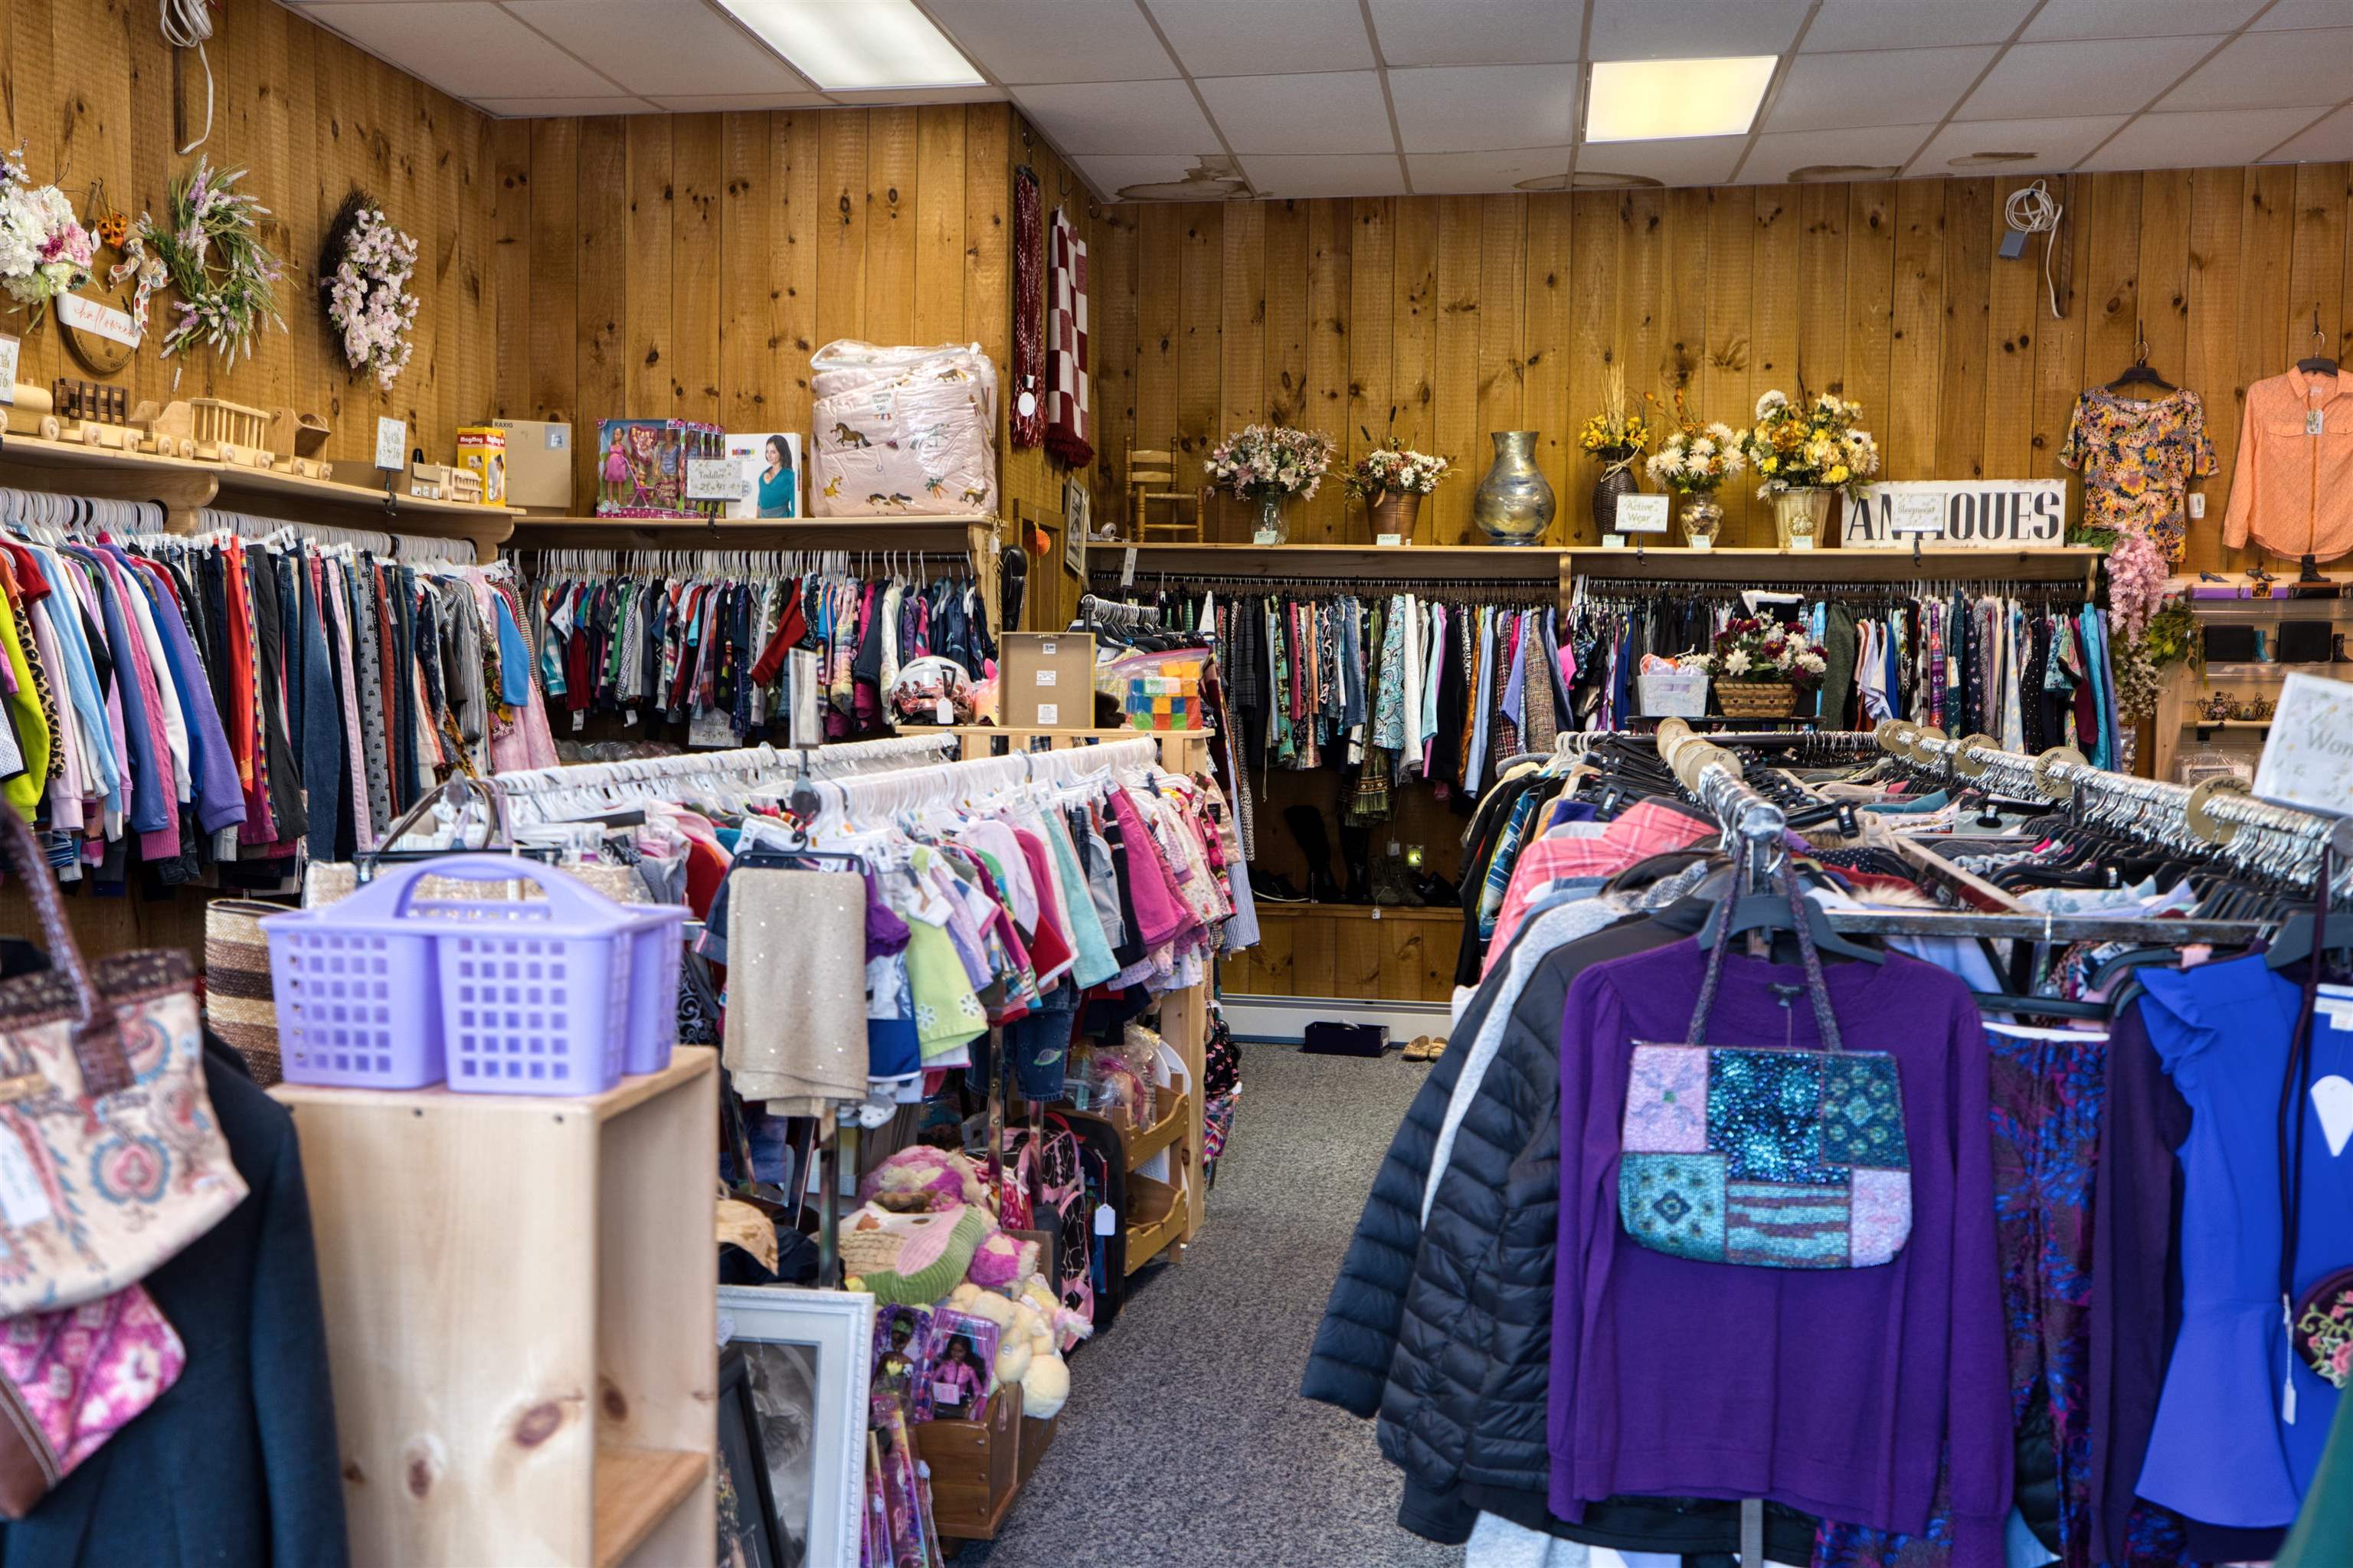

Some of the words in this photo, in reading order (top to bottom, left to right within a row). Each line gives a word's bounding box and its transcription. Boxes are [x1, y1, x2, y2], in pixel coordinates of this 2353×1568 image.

[699, 469, 725, 479] Toddler
[1625, 500, 1654, 511] Active
[1628, 513, 1651, 522] Wear
[1713, 751, 1726, 762] 16
